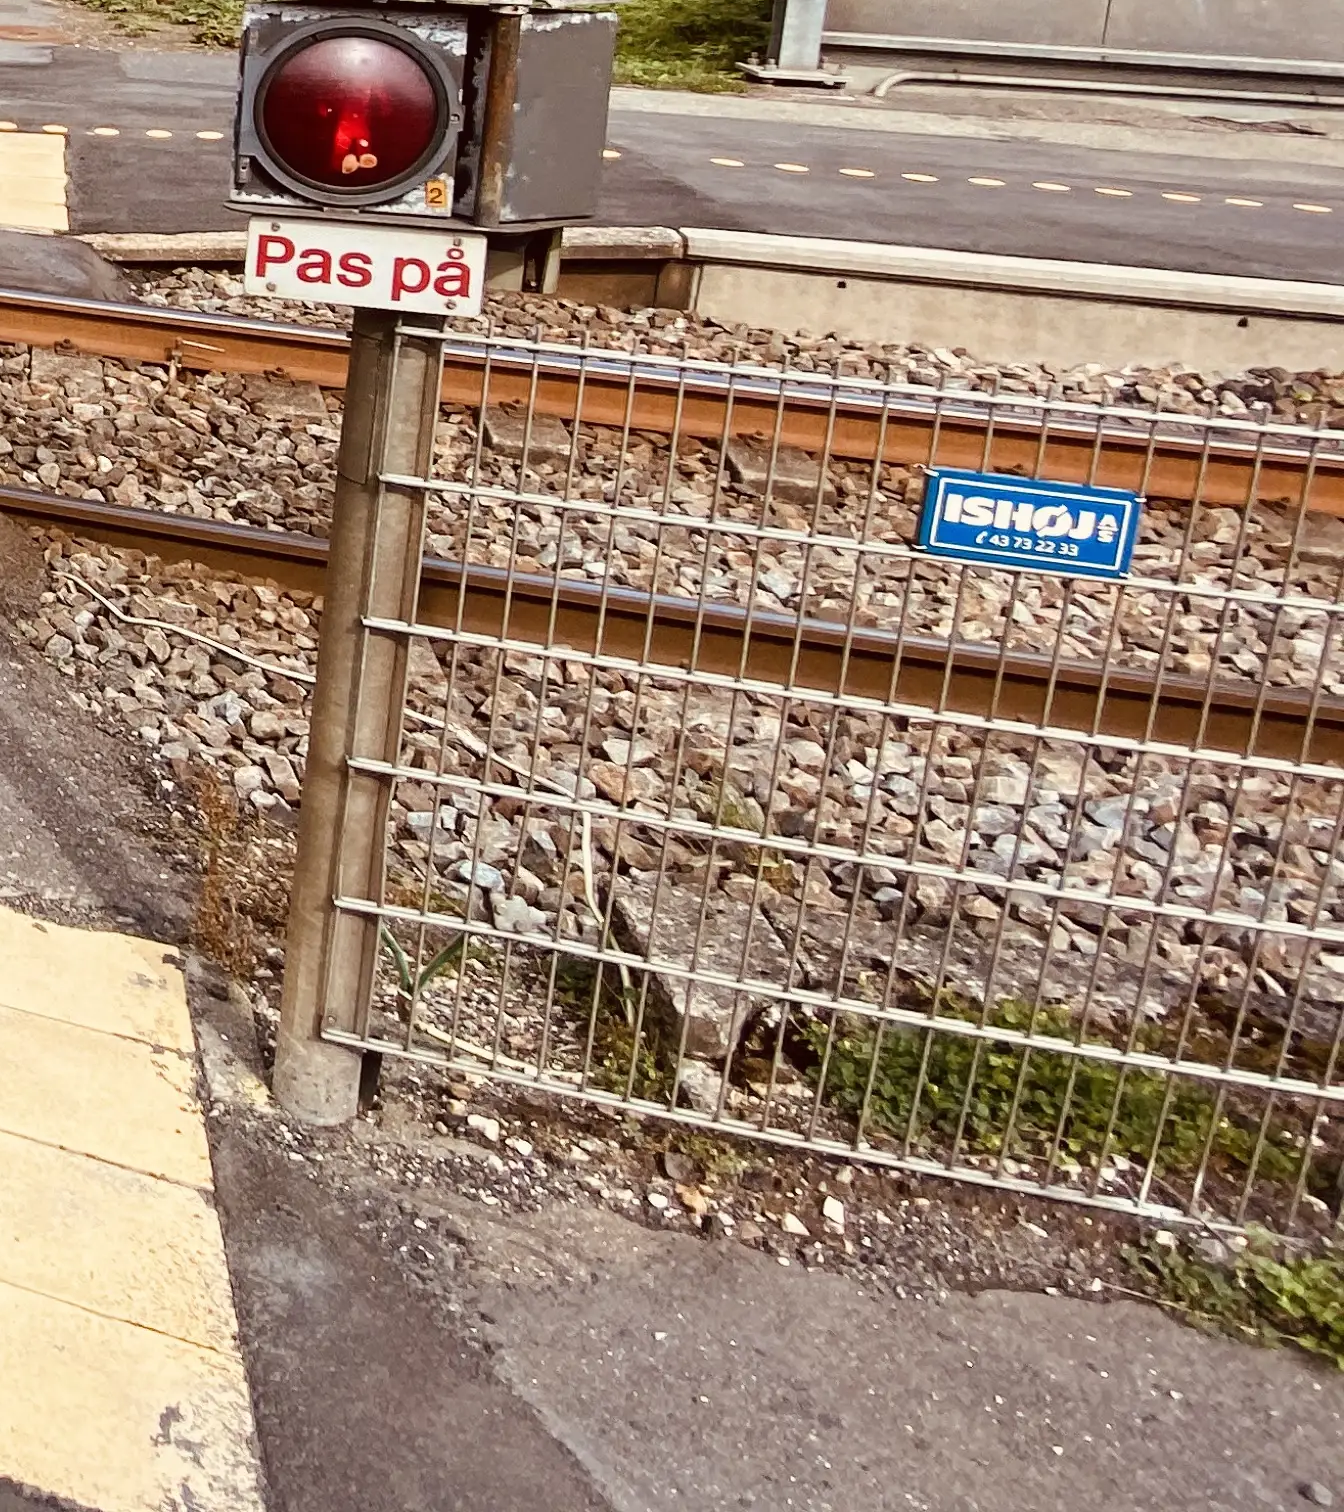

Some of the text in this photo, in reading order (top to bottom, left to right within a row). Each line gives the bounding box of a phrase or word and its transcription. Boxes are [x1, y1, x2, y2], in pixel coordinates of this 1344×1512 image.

[428, 188, 443, 204] 2
[255, 234, 471, 302] Pas på
[943, 493, 1096, 540] ISHØJ
[988, 534, 1080, 557] 43 73 22 33
